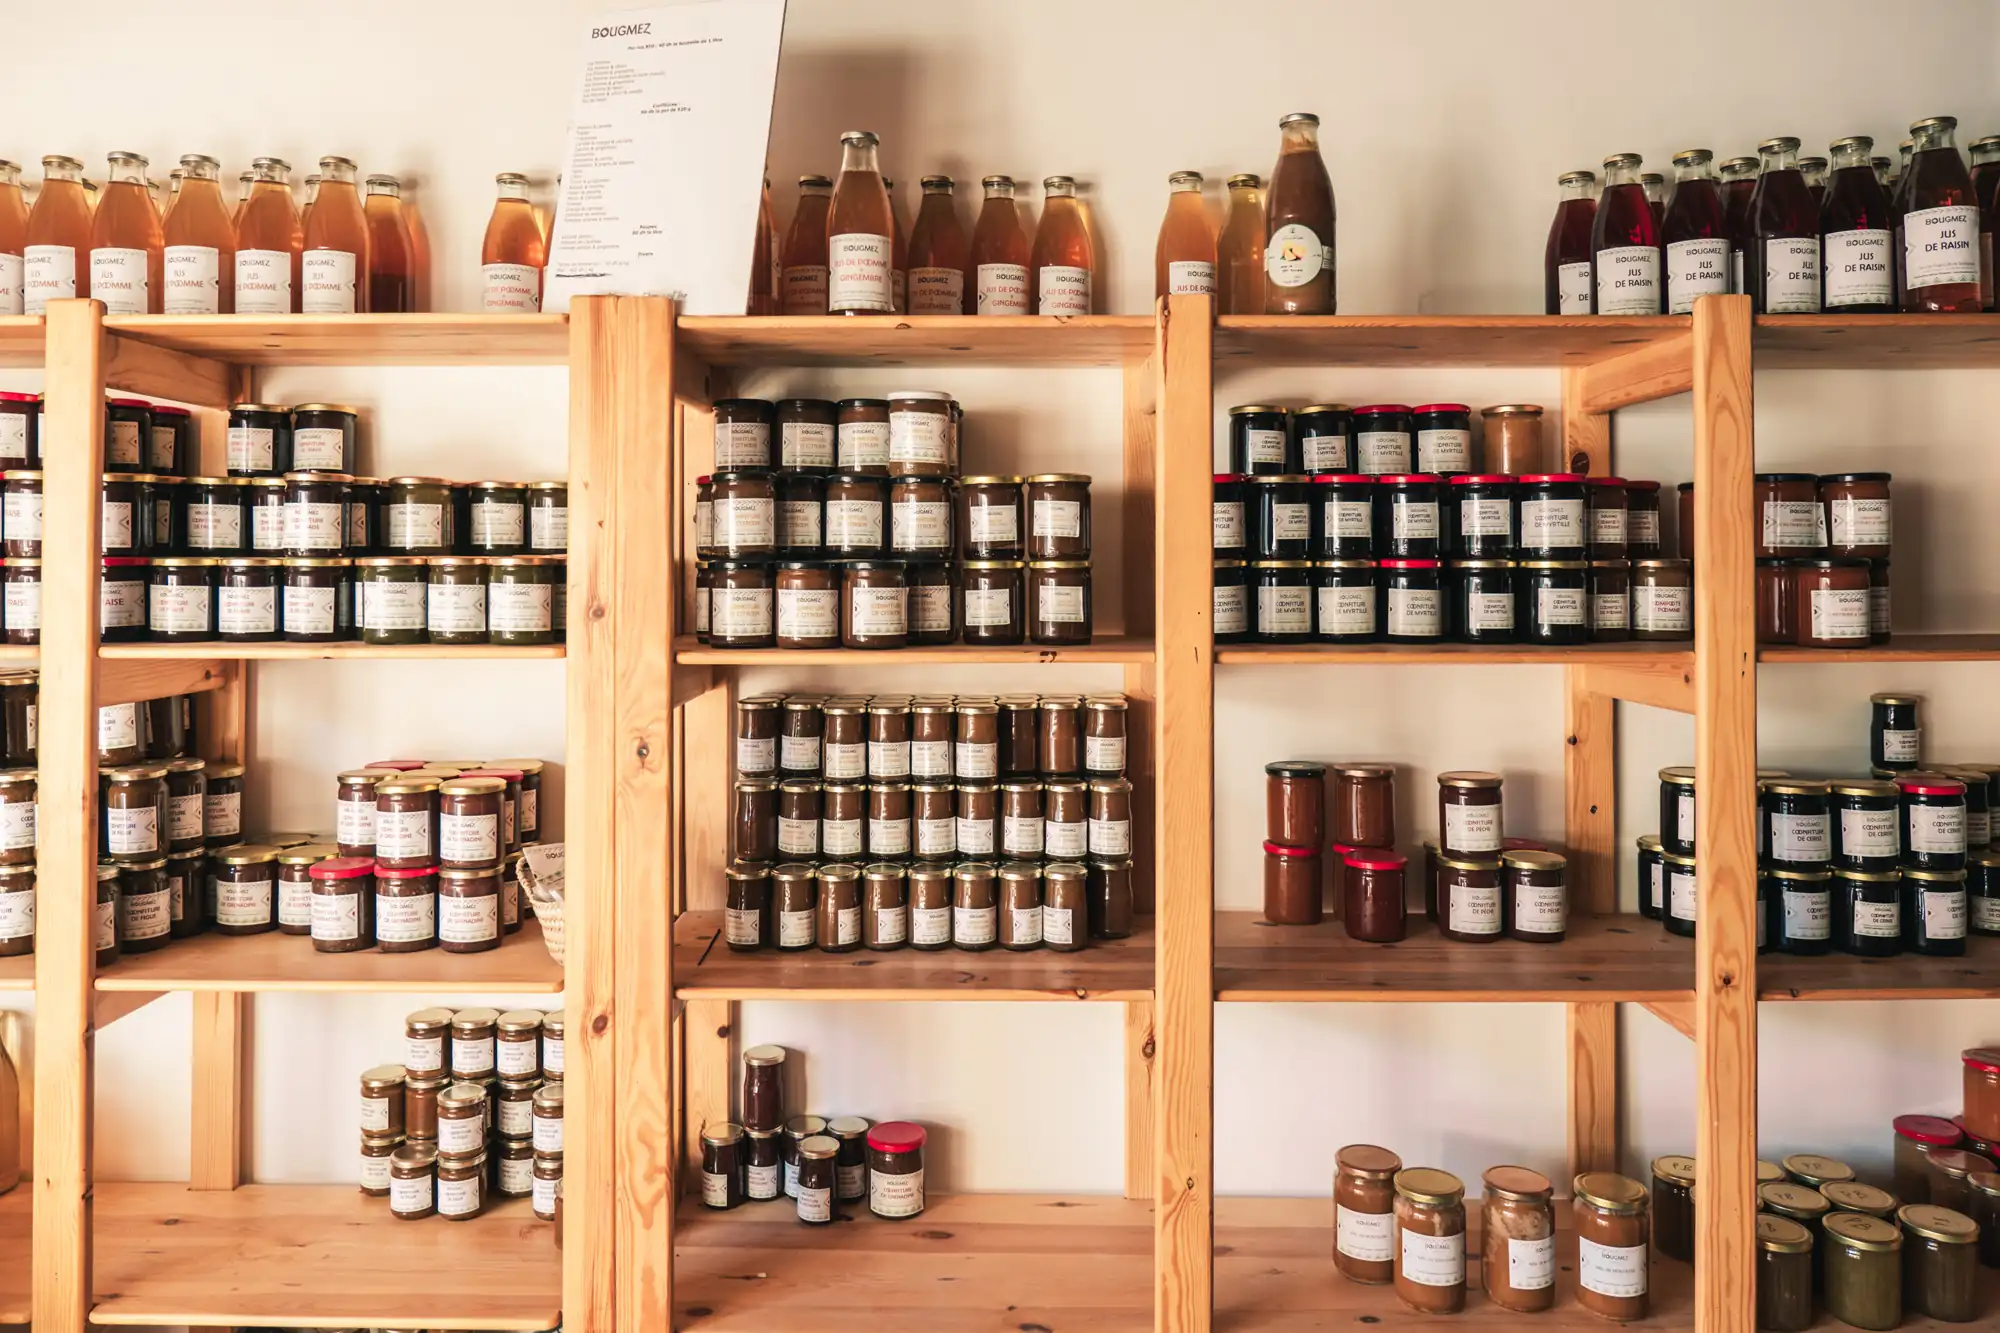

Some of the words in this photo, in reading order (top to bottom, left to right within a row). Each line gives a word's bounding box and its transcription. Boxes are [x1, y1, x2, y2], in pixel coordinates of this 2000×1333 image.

[591, 22, 652, 39] BOUGMEZ
[1925, 214, 1967, 226] BOUGMEZ
[1940, 229, 1957, 239] JUS
[1846, 239, 1885, 248] BOUGMEZ
[1925, 243, 1938, 252] DE
[1940, 240, 1970, 250] RAISIN
[843, 244, 879, 254] BOUGMEZ
[1686, 247, 1723, 256] BOUGMEZ
[1615, 255, 1652, 264] BOUGMEZ
[1858, 252, 1875, 261] JUS
[833, 258, 845, 268] JUS
[846, 258, 856, 267] DE
[1699, 260, 1713, 269] JUS
[1802, 261, 1814, 270] JUS
[1628, 268, 1642, 277] JUS
[1844, 264, 1857, 273] DE
[1859, 263, 1886, 273] RAISIN
[839, 274, 883, 283] GINGEMBRE
[918, 276, 949, 285] BOUGMEZ
[996, 273, 1026, 283] BOUGMEZ
[1056, 275, 1086, 285] BOUGMEZ
[1686, 272, 1697, 281] DE
[1700, 272, 1724, 280] RAISIN
[1788, 272, 1801, 281] DE
[1802, 272, 1817, 281] RAIS
[1615, 280, 1627, 289] DE
[1628, 278, 1653, 288] RAISIN
[1176, 284, 1188, 293] JUS
[1190, 284, 1199, 293] DE
[1578, 294, 1589, 302] DE
[130, 914, 140, 922] DE
[141, 912, 157, 920] FIGUE
